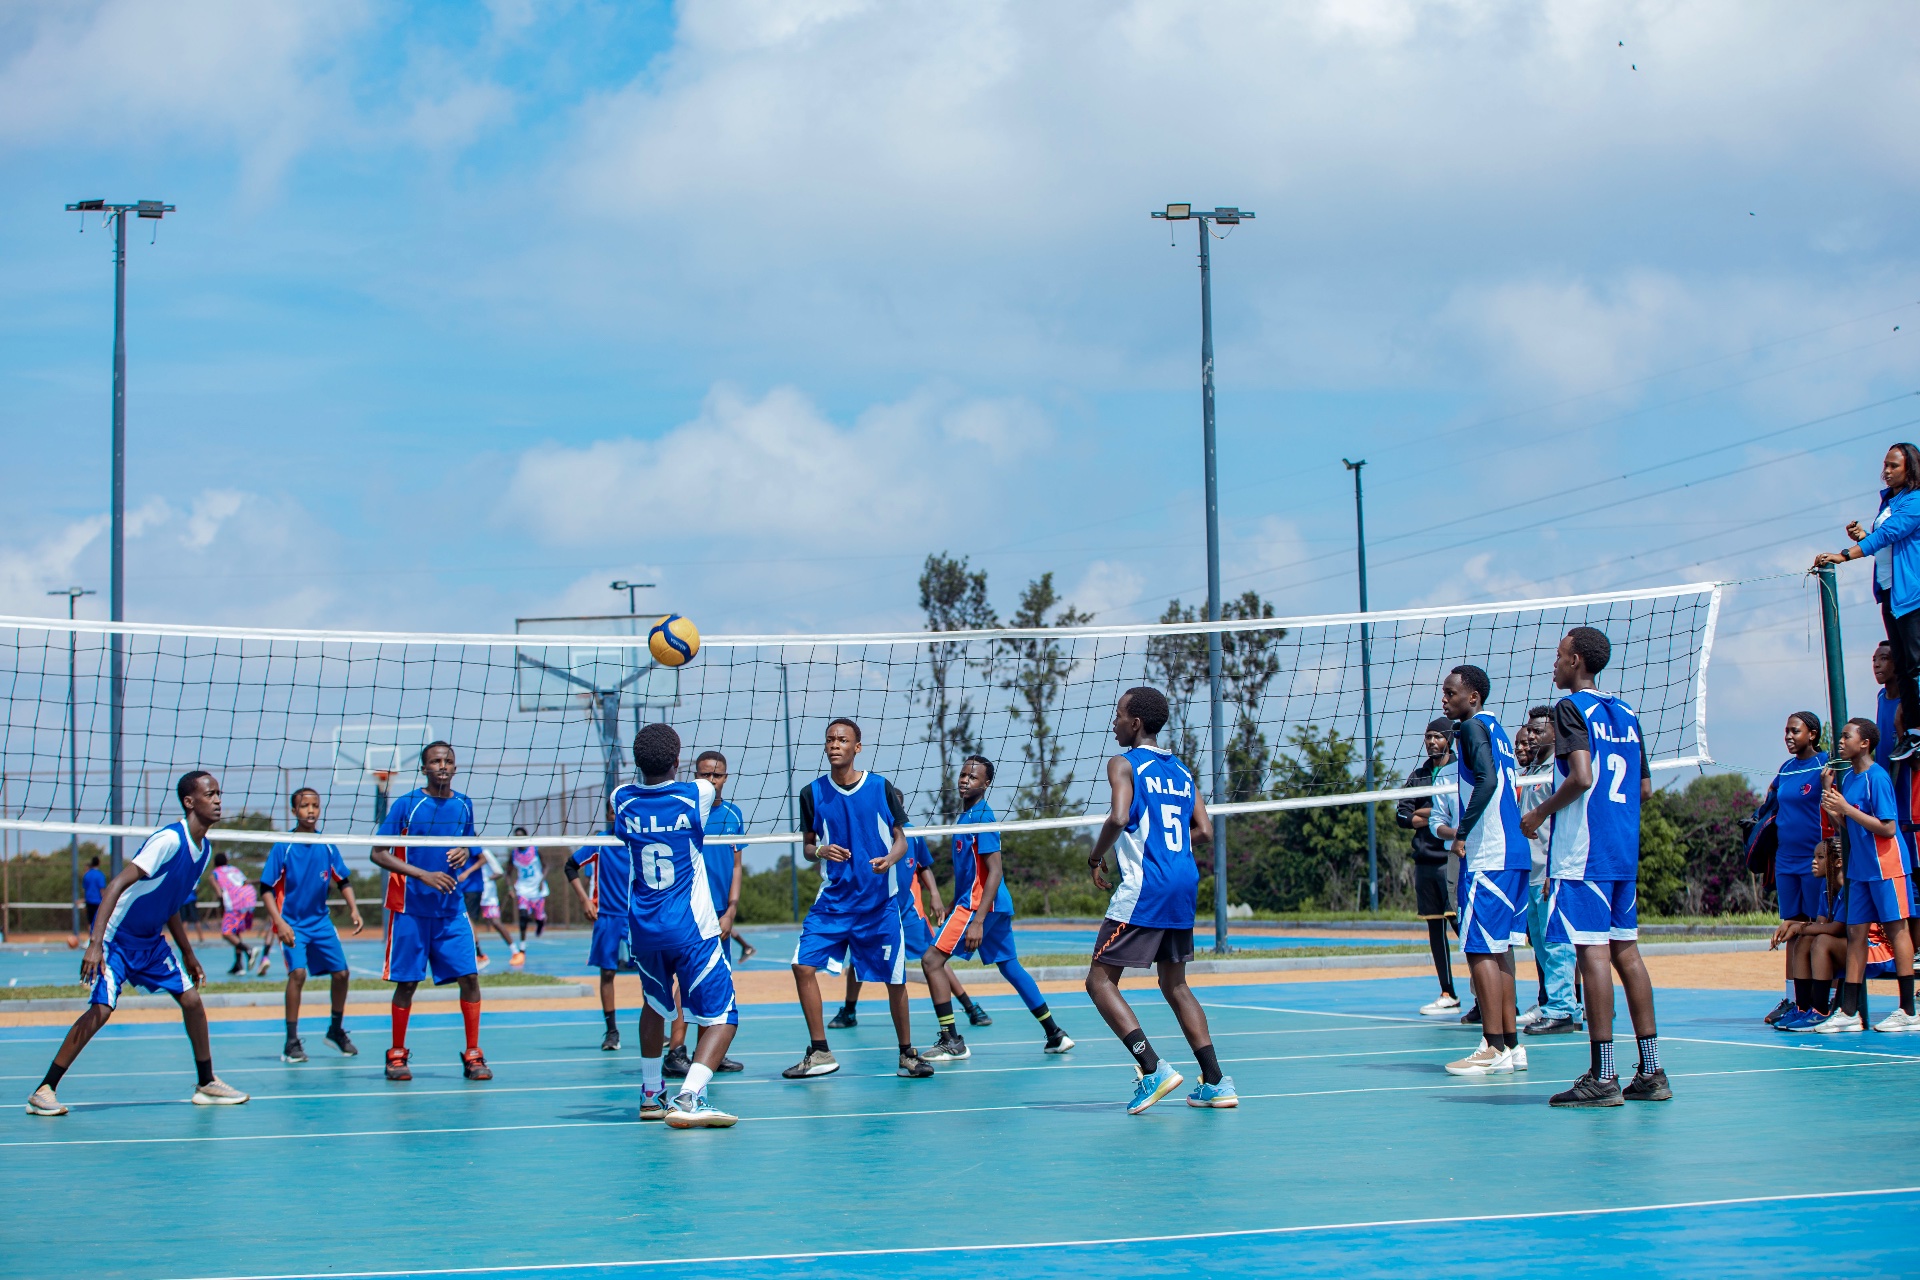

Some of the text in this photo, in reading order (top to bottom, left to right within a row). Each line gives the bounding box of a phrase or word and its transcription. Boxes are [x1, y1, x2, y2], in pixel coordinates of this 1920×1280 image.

[1592, 721, 1640, 743] N.L.A
[1145, 776, 1191, 799] N.L.A
[1607, 753, 1627, 804] 2
[624, 813, 692, 834] N.L.A
[1161, 803, 1183, 852] 5
[641, 842, 675, 890] 6
